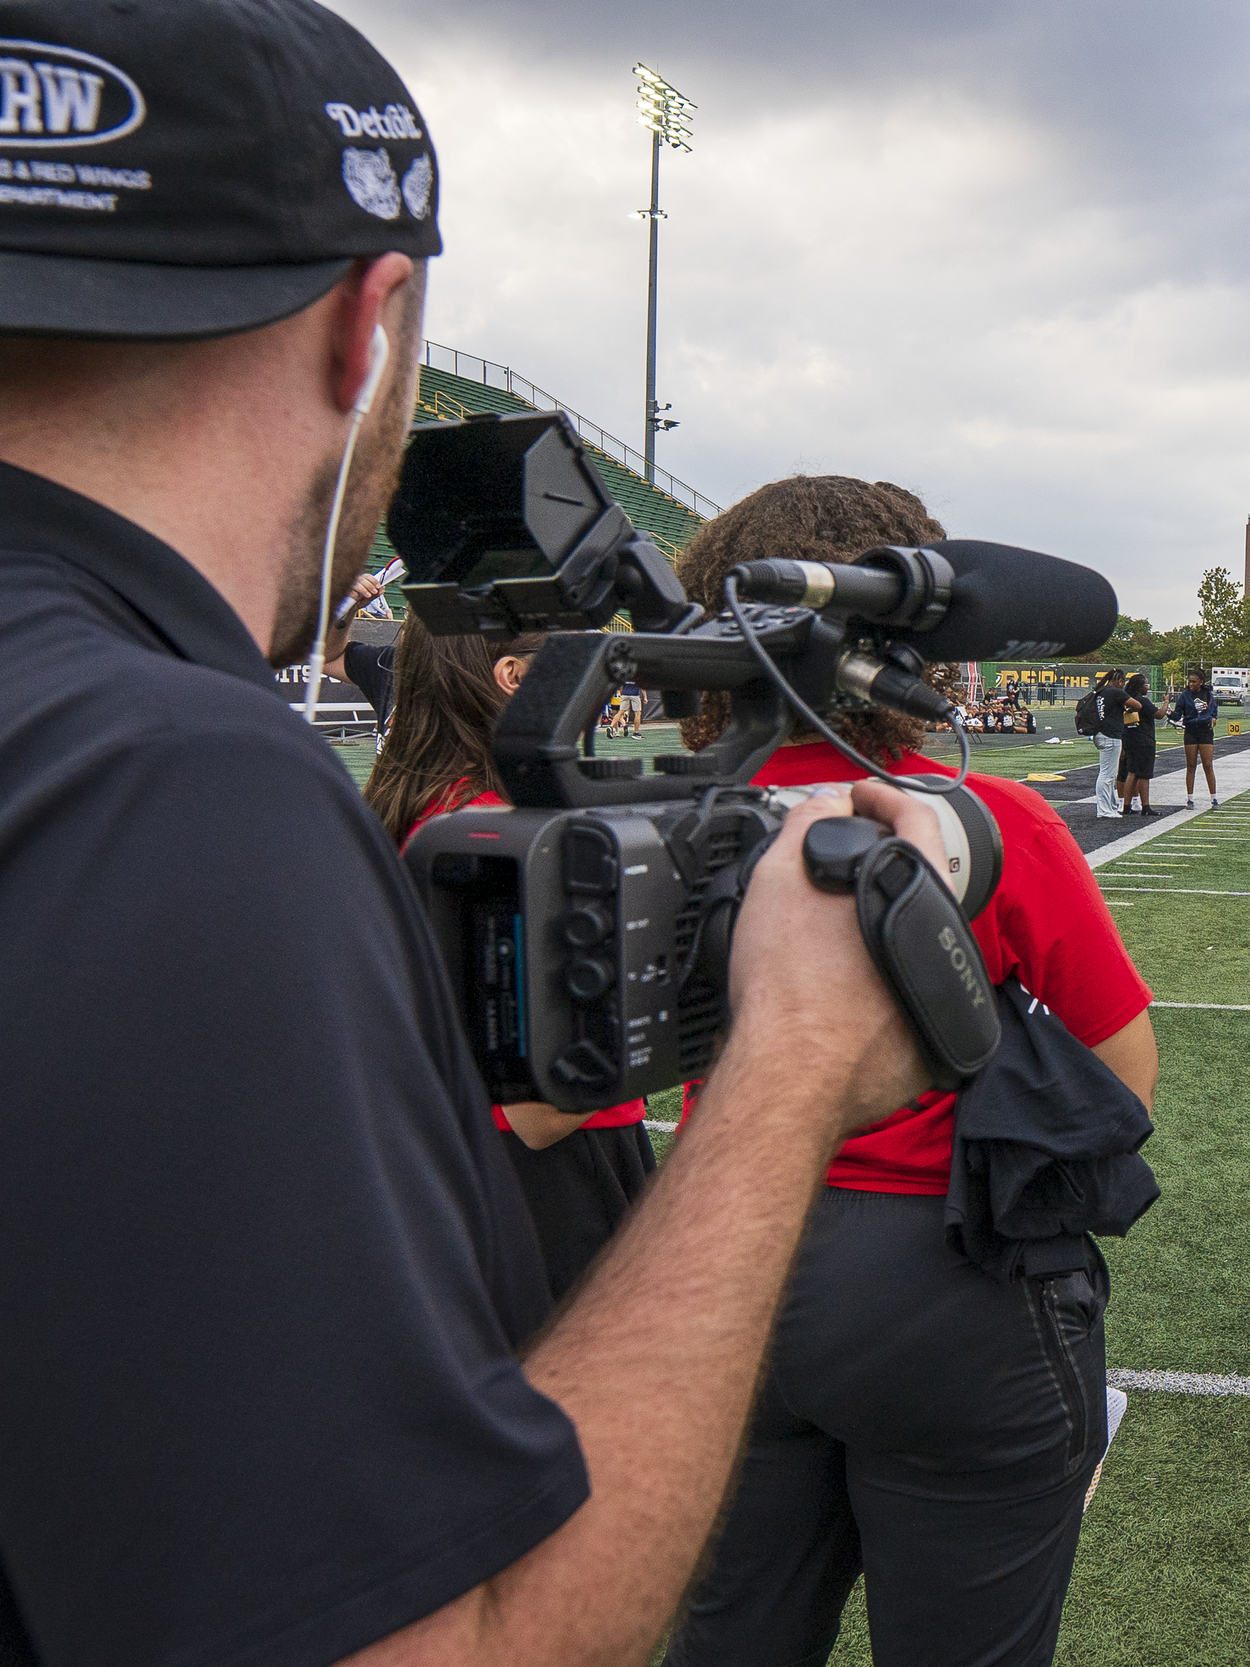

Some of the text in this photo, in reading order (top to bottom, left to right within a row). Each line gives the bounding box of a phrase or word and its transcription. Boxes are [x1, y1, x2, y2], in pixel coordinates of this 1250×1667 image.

[324, 102, 422, 139] Detroit
[1060, 676, 1090, 688] THE
[1229, 724, 1240, 733] 30
[938, 926, 986, 1008] SONY
